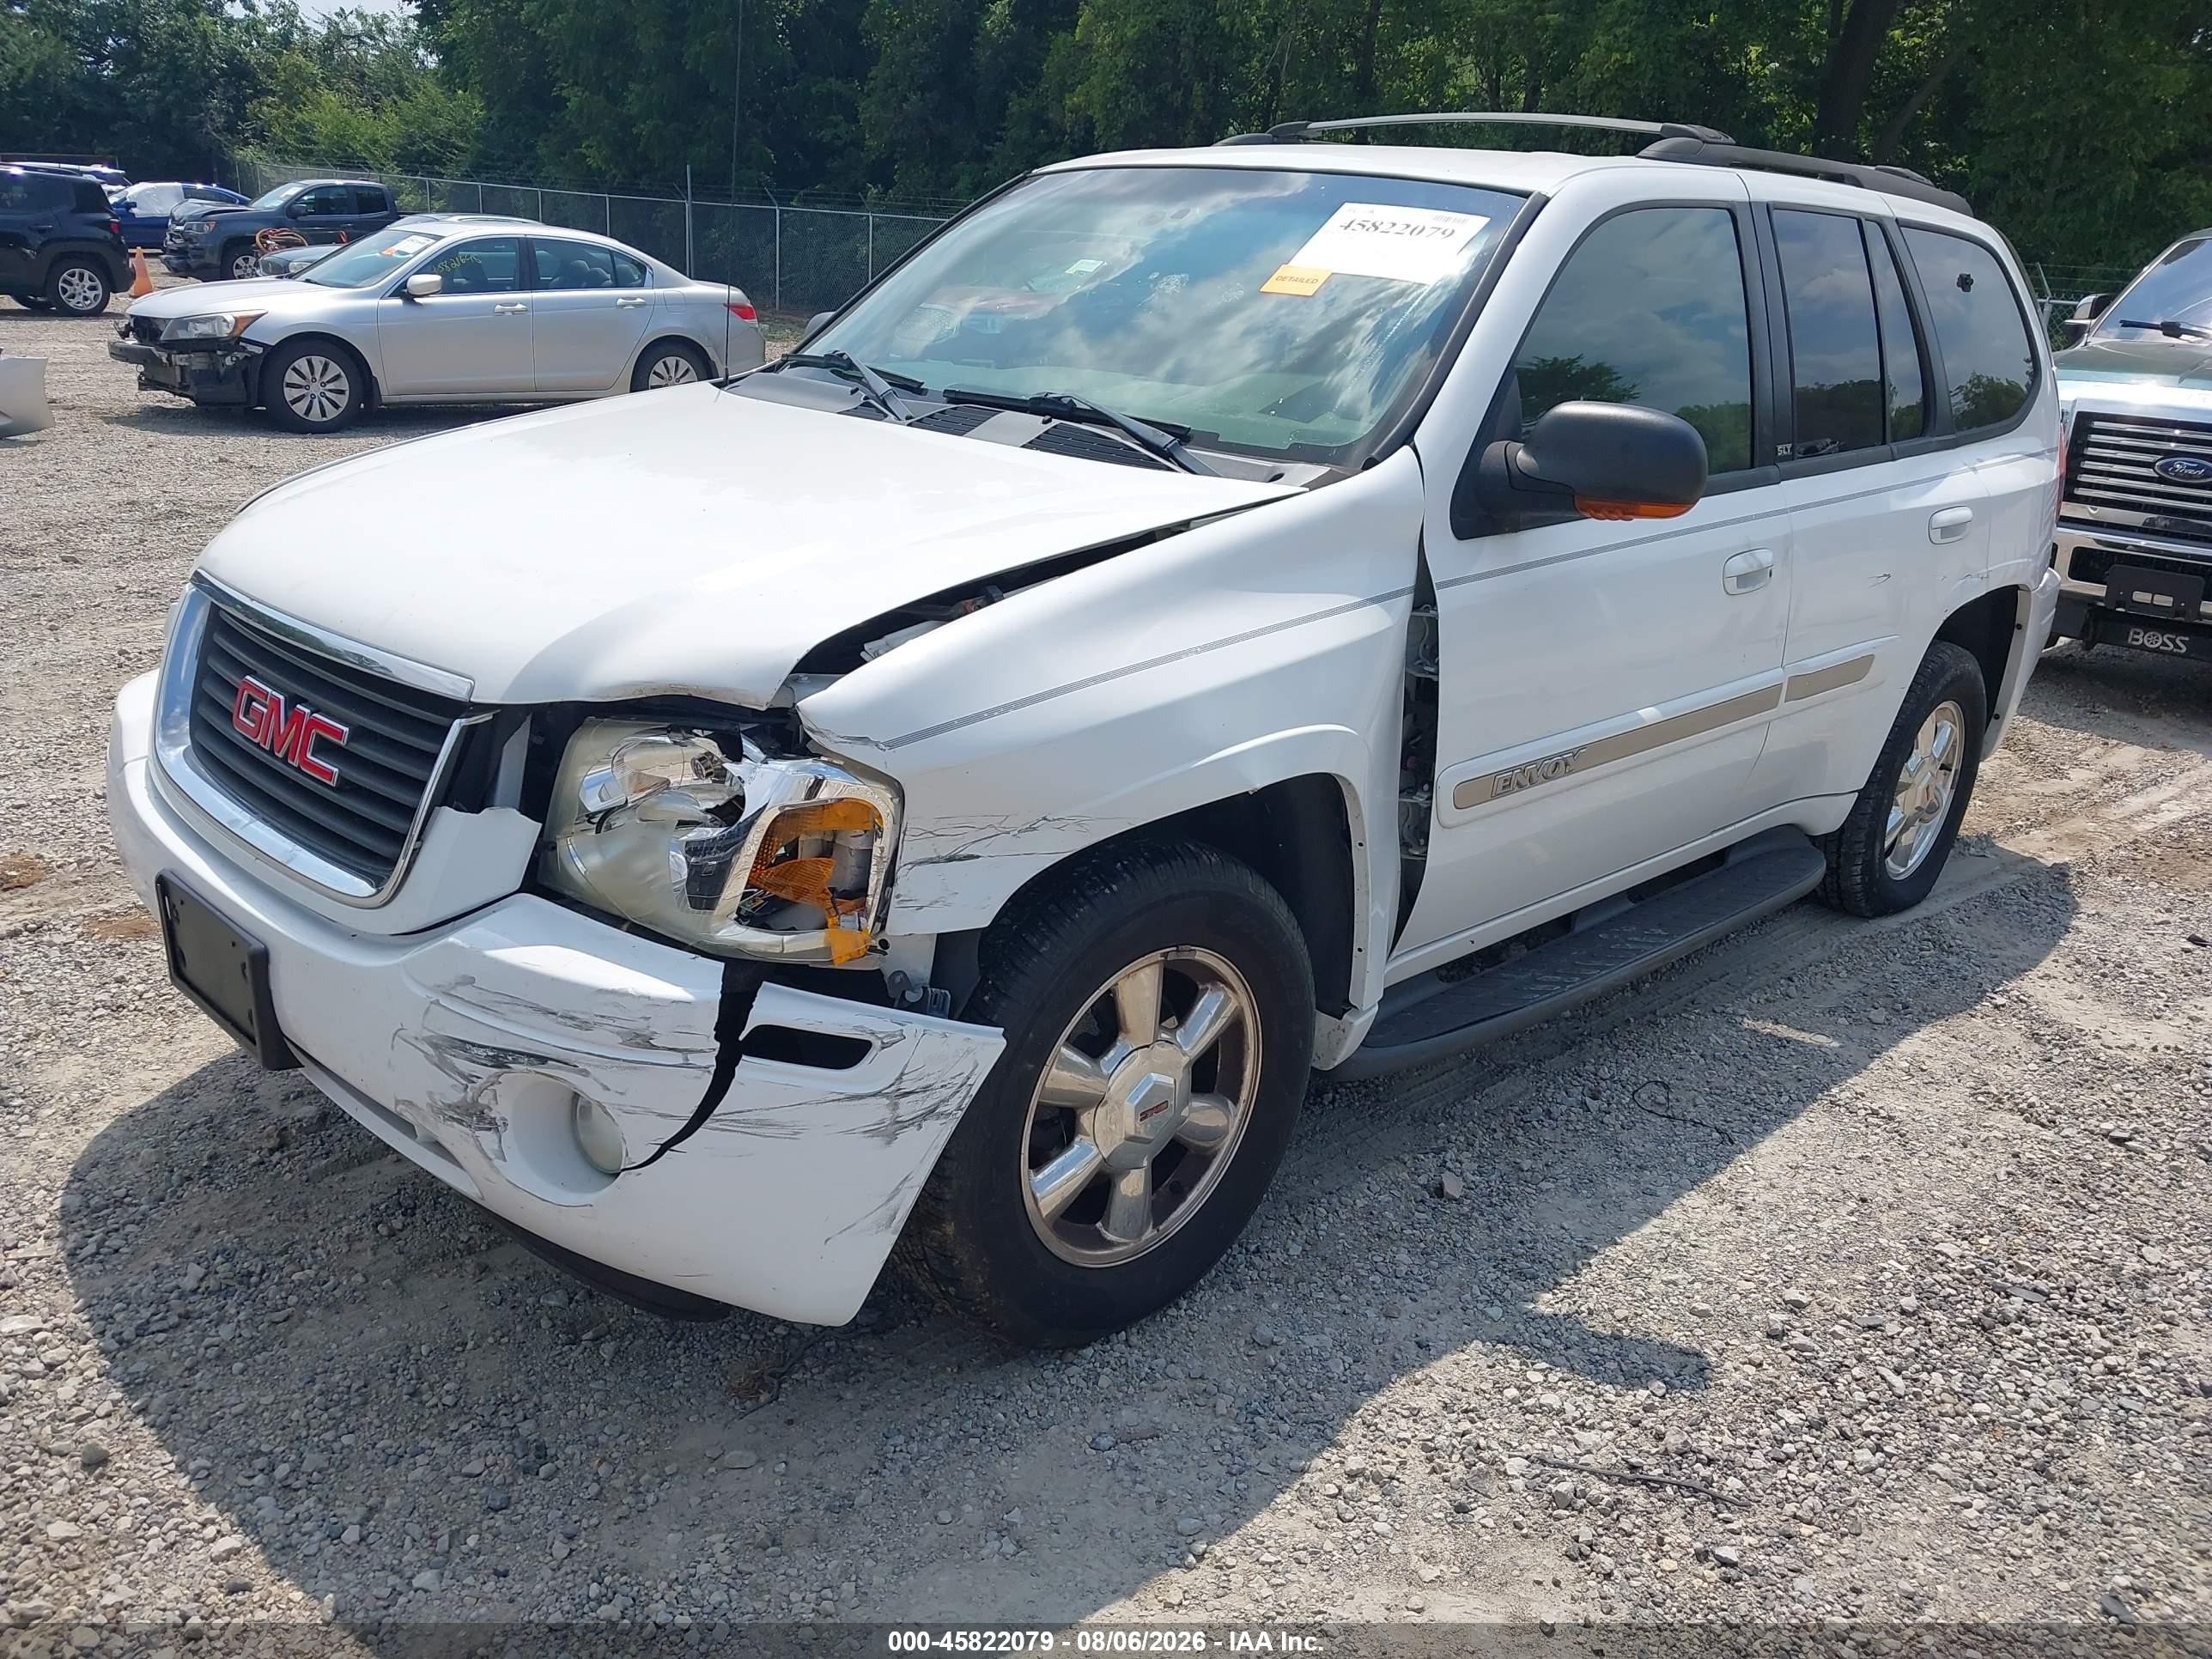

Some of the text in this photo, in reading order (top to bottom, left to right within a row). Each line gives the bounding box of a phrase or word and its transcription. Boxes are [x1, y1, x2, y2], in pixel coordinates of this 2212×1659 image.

[1340, 218, 1455, 239] 45822079
[1275, 275, 1319, 284] DETAILED
[2167, 460, 2205, 476] Ford
[2128, 628, 2190, 653] BOSS
[233, 675, 349, 787] GMC
[1491, 746, 1587, 798] ENVOY
